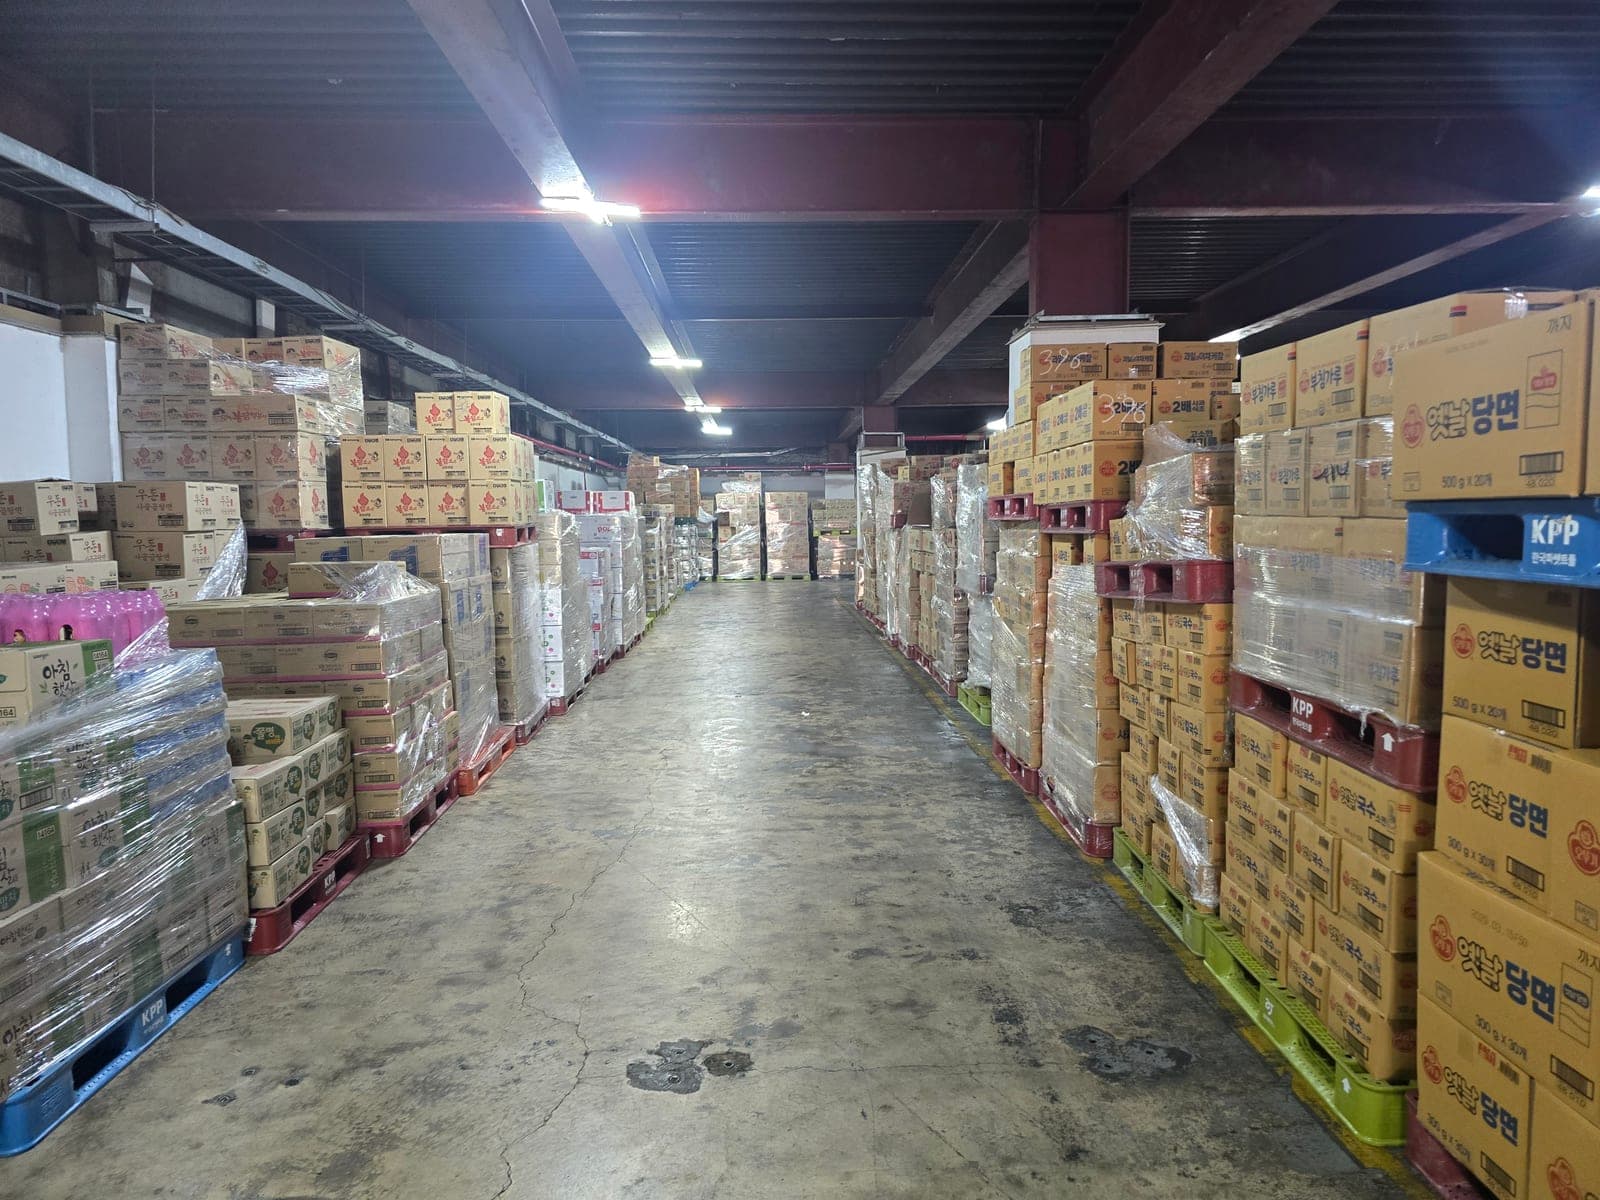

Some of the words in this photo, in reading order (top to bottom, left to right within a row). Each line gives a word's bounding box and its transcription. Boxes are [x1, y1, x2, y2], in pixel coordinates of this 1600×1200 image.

[1310, 365, 1342, 393] 부침가루
[1251, 381, 1277, 404] 부침가루
[1531, 515, 1580, 545] KPP
[42, 658, 71, 682] 아침
[1292, 696, 1314, 719] KPP
[142, 998, 164, 1027] KPP
